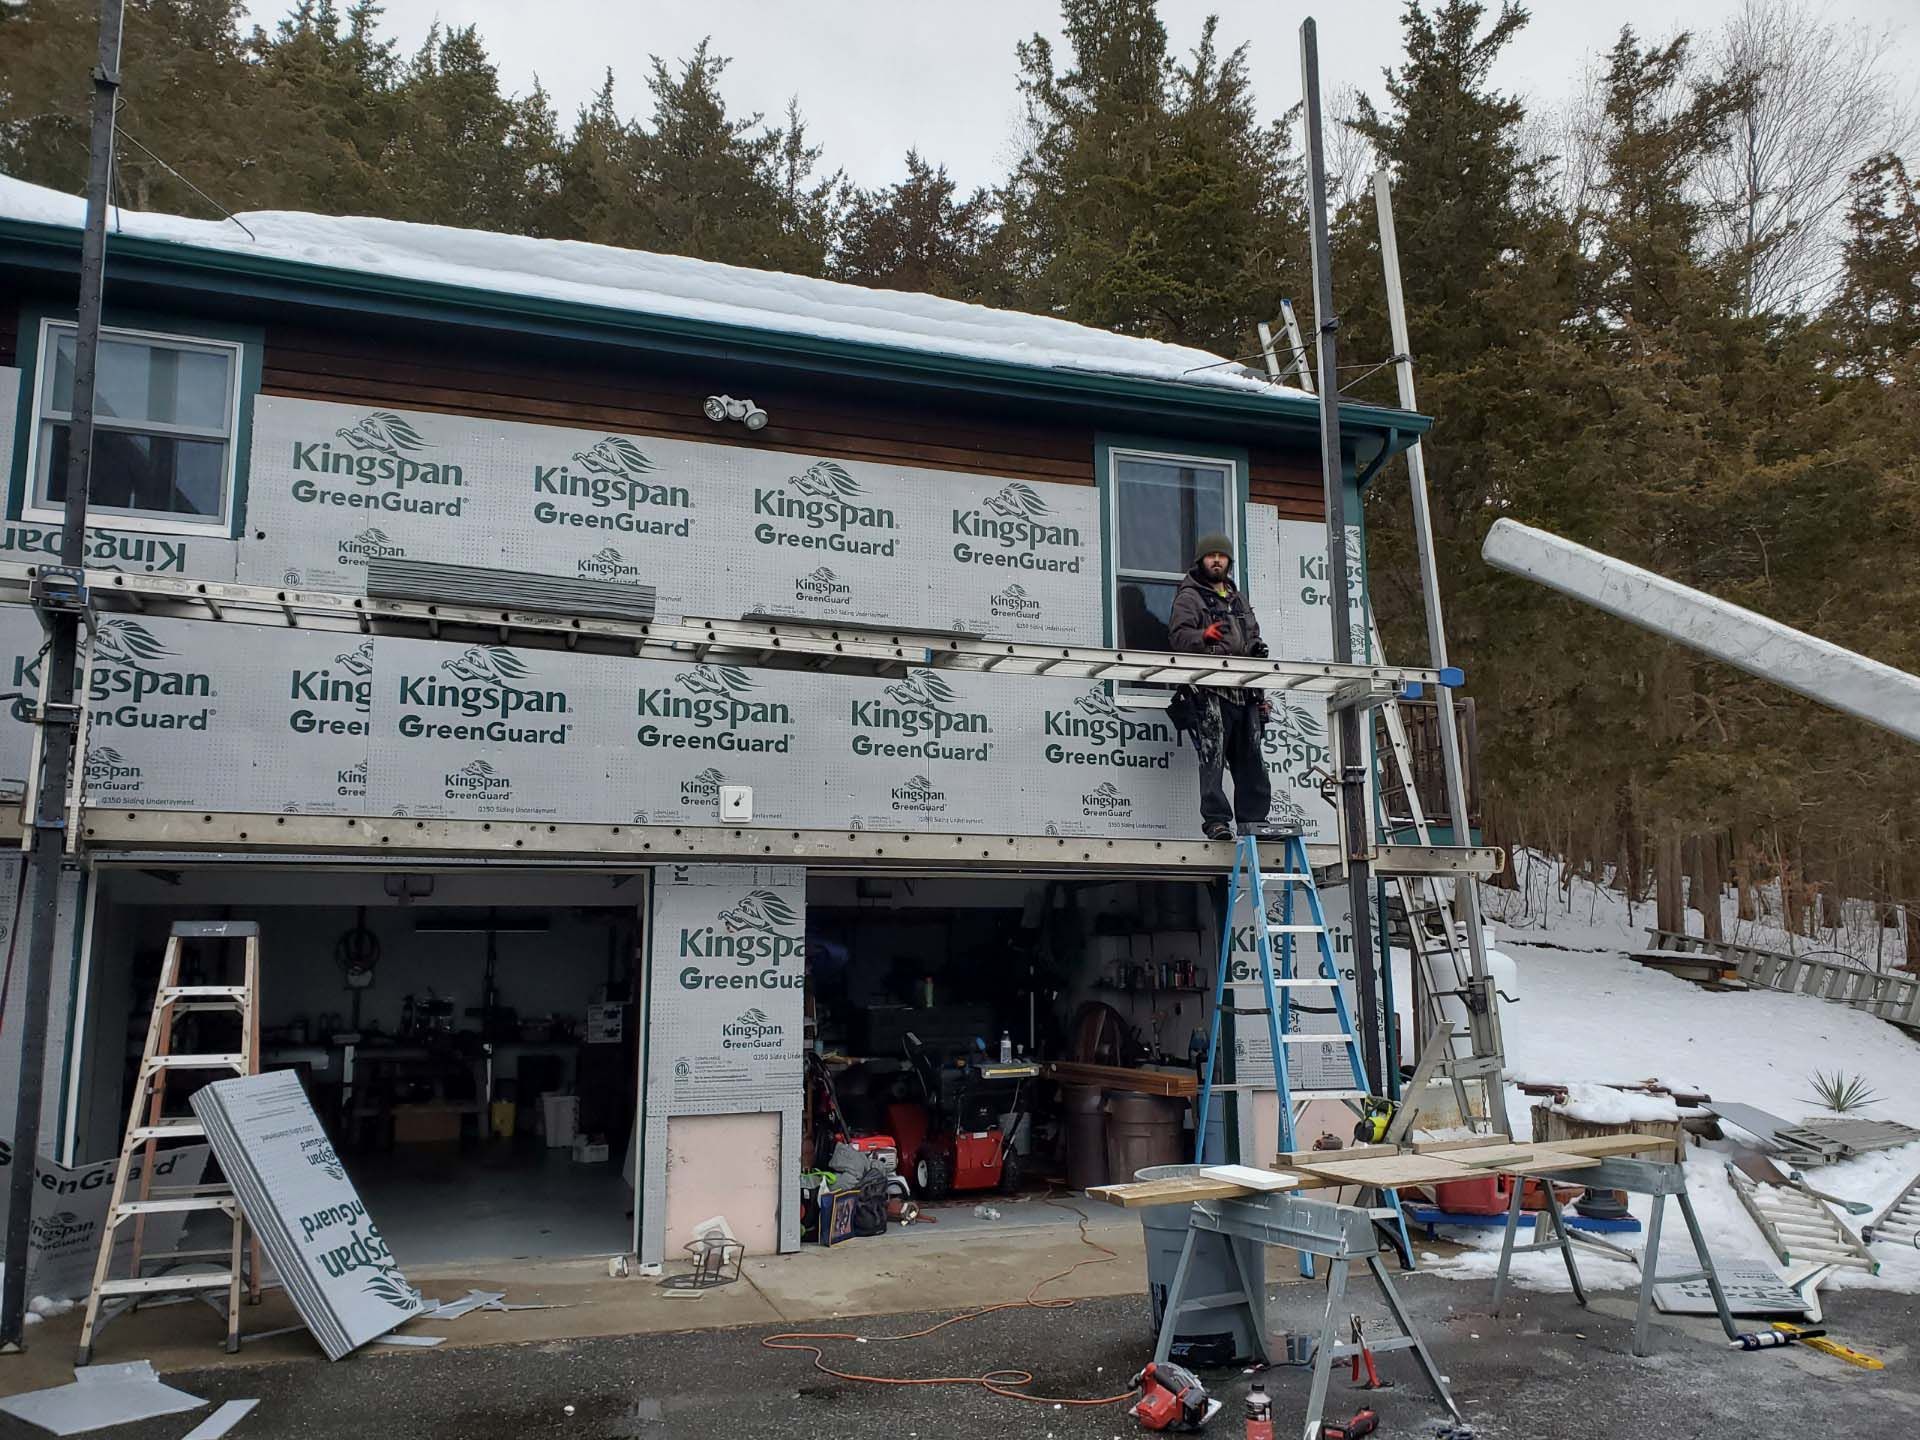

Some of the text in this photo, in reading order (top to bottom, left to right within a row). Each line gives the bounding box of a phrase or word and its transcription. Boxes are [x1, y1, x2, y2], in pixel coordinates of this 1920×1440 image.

[293, 441, 463, 489] Kingspan
[292, 480, 462, 517] GreenGuard
[534, 465, 689, 510] Kingspan
[534, 502, 689, 537] GreenGuard
[755, 488, 894, 531] Kingspan
[755, 523, 894, 556] GreenGuard
[953, 509, 1079, 550] Kingspan
[338, 540, 405, 557] Kingspan
[953, 543, 1080, 573] GreenGuard
[578, 560, 639, 576] Kingspan
[796, 579, 850, 594] Kingspan
[796, 592, 850, 604] GreenGuard
[991, 595, 1040, 609] Kingspan
[991, 608, 1040, 619] GreenGuard
[291, 670, 371, 713] King
[400, 676, 567, 718] Kingspan
[638, 688, 789, 729] Kingspan
[852, 700, 988, 738] Kingspan
[399, 714, 566, 744] GreenGuard
[638, 725, 789, 753] GreenGuard
[1045, 710, 1168, 747] Kingspan
[852, 735, 988, 761] GreenGuard
[1045, 744, 1169, 769] GreenGuard
[445, 774, 510, 790] Kingspan
[445, 789, 510, 800] GreenGuard
[681, 796, 719, 806] GreenG
[892, 788, 945, 802] Kingspan
[892, 801, 945, 812] GreenGuard
[1082, 795, 1130, 808] Kingspan
[1083, 807, 1131, 817] GreenGuard
[680, 928, 804, 966] Kingspa
[680, 967, 804, 990] GreenGua
[722, 1024, 782, 1038] Kingspan
[722, 1038, 782, 1049] GreenGuard
